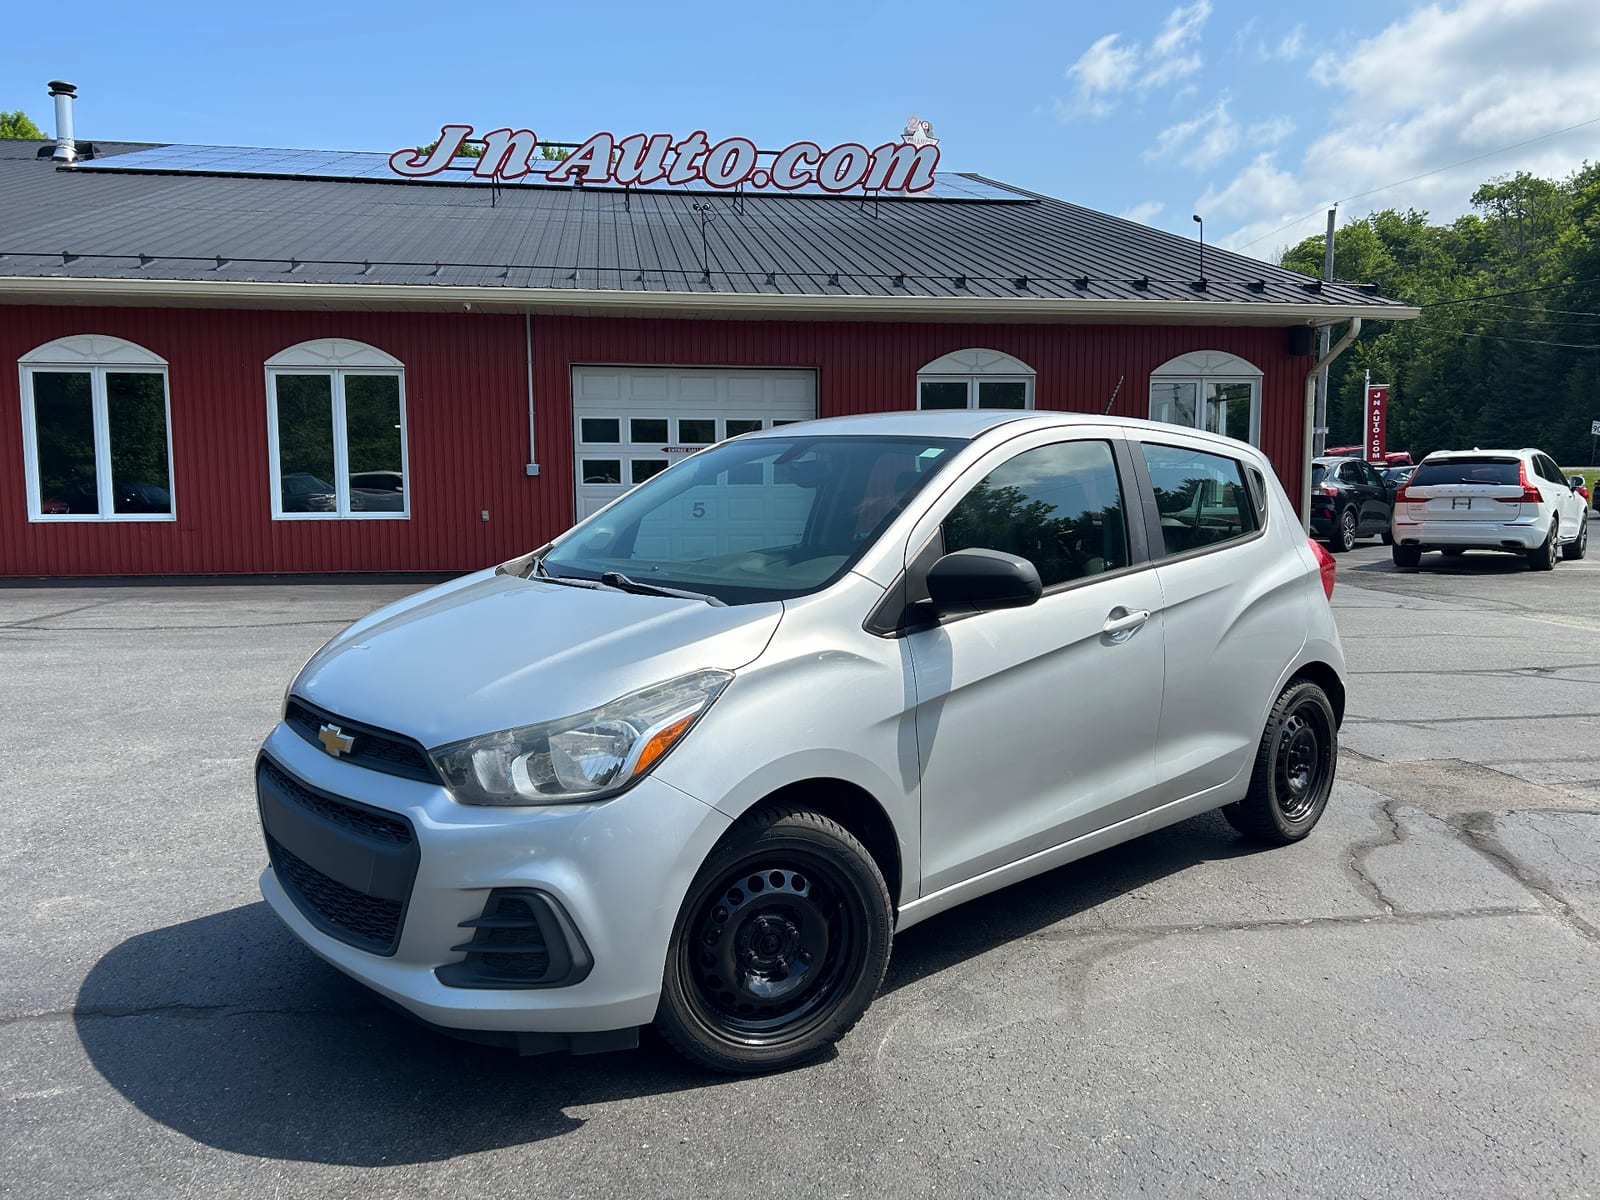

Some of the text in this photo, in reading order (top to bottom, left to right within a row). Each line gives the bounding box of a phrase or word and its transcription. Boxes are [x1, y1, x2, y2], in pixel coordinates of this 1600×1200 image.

[545, 130, 941, 193] Auto.com
[1373, 392, 1381, 406] JN
[692, 501, 706, 518] 5
